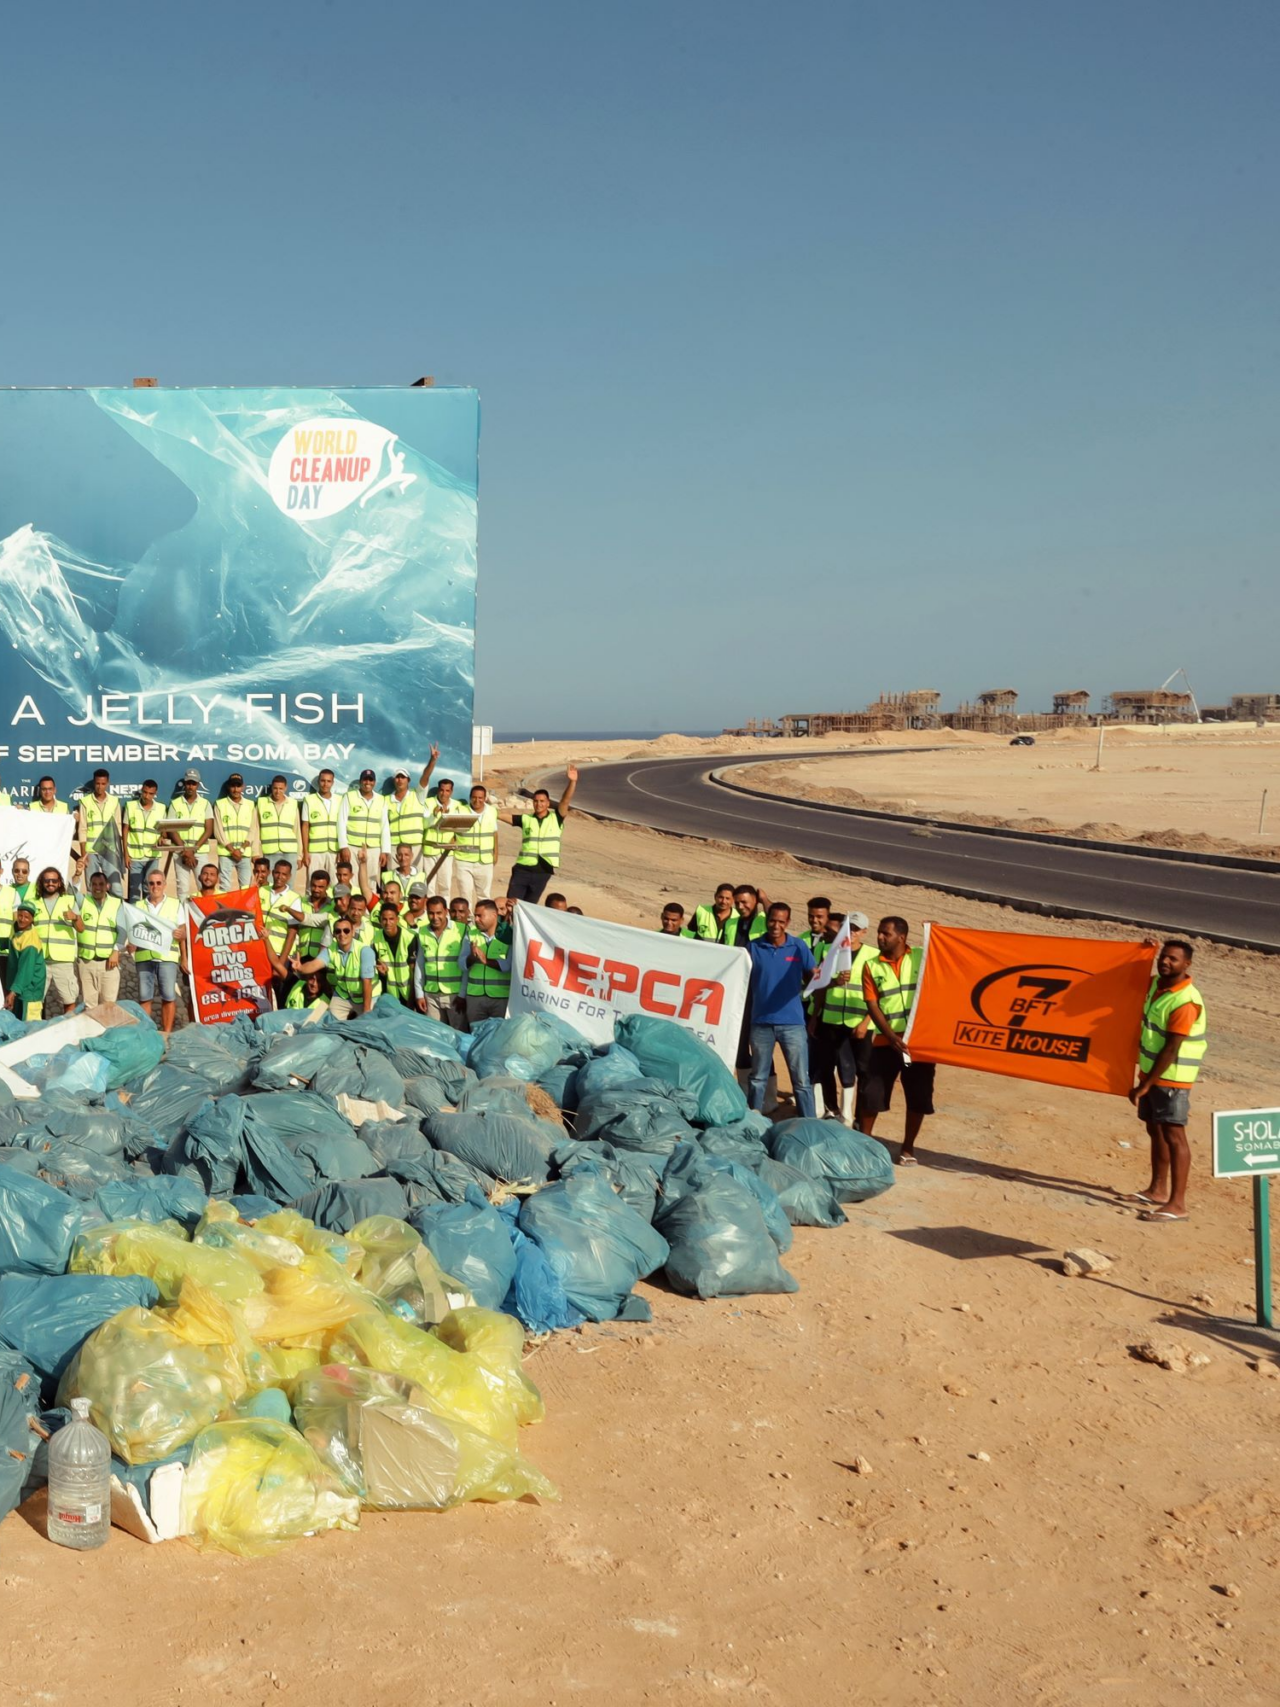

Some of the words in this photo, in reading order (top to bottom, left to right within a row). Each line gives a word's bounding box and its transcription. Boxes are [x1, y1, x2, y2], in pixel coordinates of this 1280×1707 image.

[293, 429, 358, 455] WORLD
[289, 456, 371, 484] CLEANUP
[286, 484, 323, 510] DAY
[10, 694, 46, 726] A
[66, 692, 223, 726] JELLY
[246, 692, 365, 725] FISH
[17, 744, 180, 763] SEPTEMBER
[186, 743, 219, 761] AT
[226, 743, 356, 761] SOMABAY
[133, 926, 162, 947] ORCA
[201, 922, 260, 948] ORCA
[212, 951, 248, 967] Dive
[211, 965, 254, 984] Clubs
[523, 938, 725, 1026] HEPCA
[201, 990, 231, 1006] est.
[1009, 998, 1057, 1017] BFT
[959, 1026, 1006, 1047] KITE
[1010, 1033, 1084, 1058] HOUSE
[1233, 1120, 1280, 1142] SHOL
